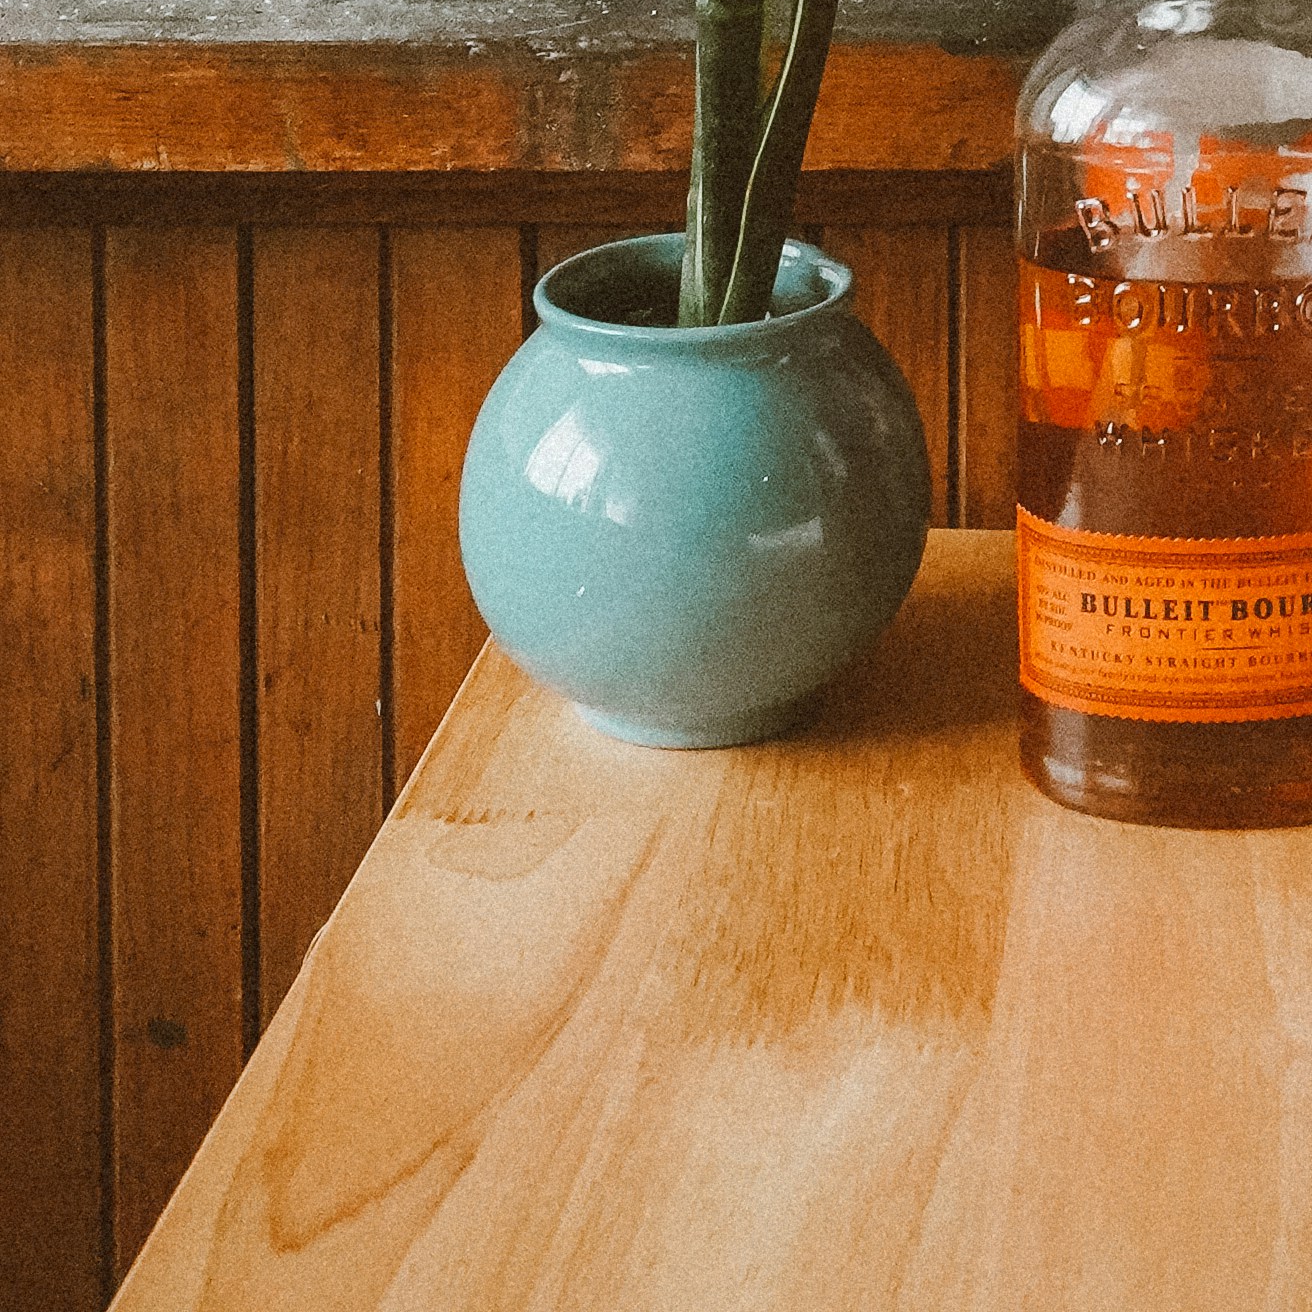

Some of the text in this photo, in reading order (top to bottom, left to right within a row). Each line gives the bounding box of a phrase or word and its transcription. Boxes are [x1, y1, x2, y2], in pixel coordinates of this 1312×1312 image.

[1102, 574, 1129, 585] AND
[1135, 575, 1176, 588] AGED
[1080, 591, 1215, 621] BULLEIT
[1106, 623, 1234, 642] FRONTIER
[1050, 640, 1134, 664] KENTUCKY
[1146, 655, 1238, 669] STRAIGHT
